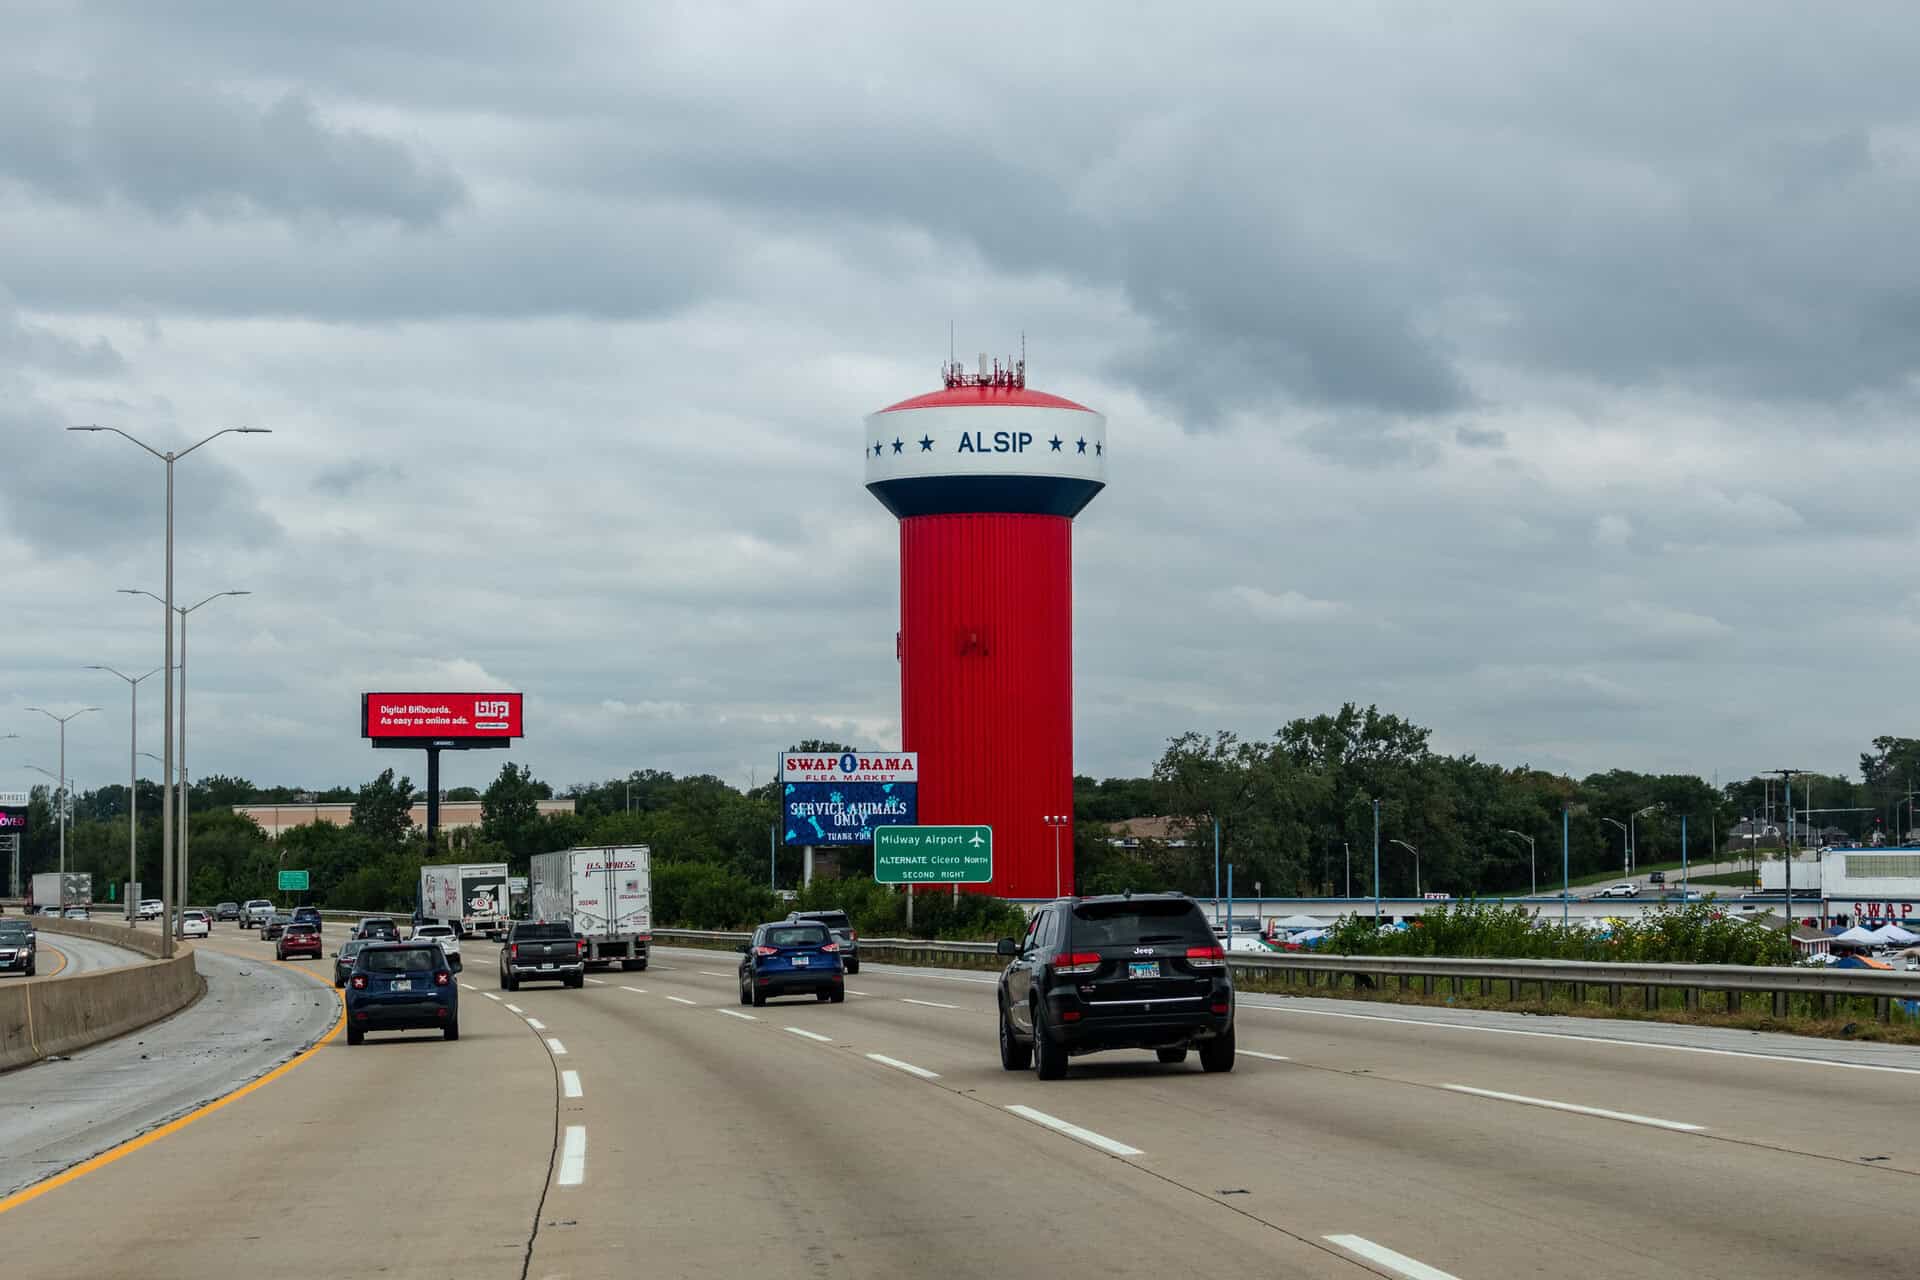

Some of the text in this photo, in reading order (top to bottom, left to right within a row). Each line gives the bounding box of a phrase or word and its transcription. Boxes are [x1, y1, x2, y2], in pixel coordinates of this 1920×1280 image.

[958, 431, 1033, 453] ALSIP
[381, 705, 452, 715] Digital Billboards.
[475, 701, 509, 719] blip
[381, 716, 392, 725] As
[393, 717, 413, 726] easy
[414, 717, 424, 725] as
[425, 716, 450, 725] online
[452, 716, 470, 725] ads.
[787, 758, 838, 771] SWAP
[859, 758, 914, 770] RAMA
[790, 802, 907, 816] SERVICE ANIMALS
[833, 814, 867, 827] ONLY
[827, 832, 853, 841] THANK
[881, 834, 963, 846] Midway Airport
[880, 856, 928, 864] ALTERNATE
[931, 856, 960, 864] Cicero
[902, 871, 935, 879] SECOND
[1854, 902, 1913, 919] SWAP
[1133, 946, 1154, 956] Jeep
